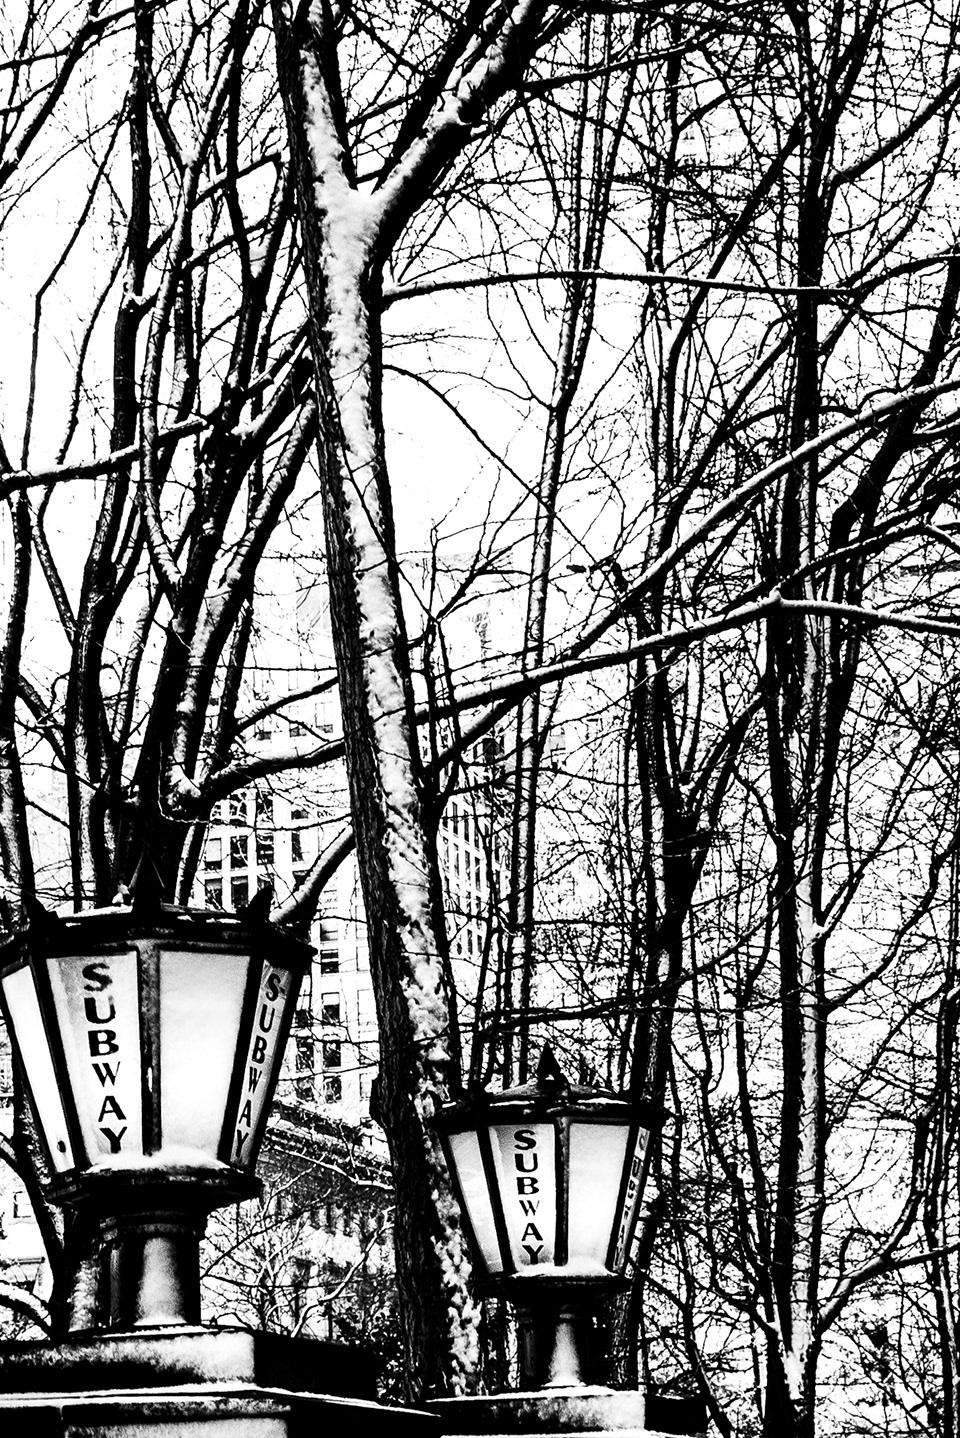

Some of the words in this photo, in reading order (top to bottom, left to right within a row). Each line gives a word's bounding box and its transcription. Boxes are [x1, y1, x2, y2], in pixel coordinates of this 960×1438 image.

[81, 962, 128, 1155] SUBWAY
[236, 973, 284, 1158] SUBWAY
[513, 1129, 544, 1266] SUBWAY
